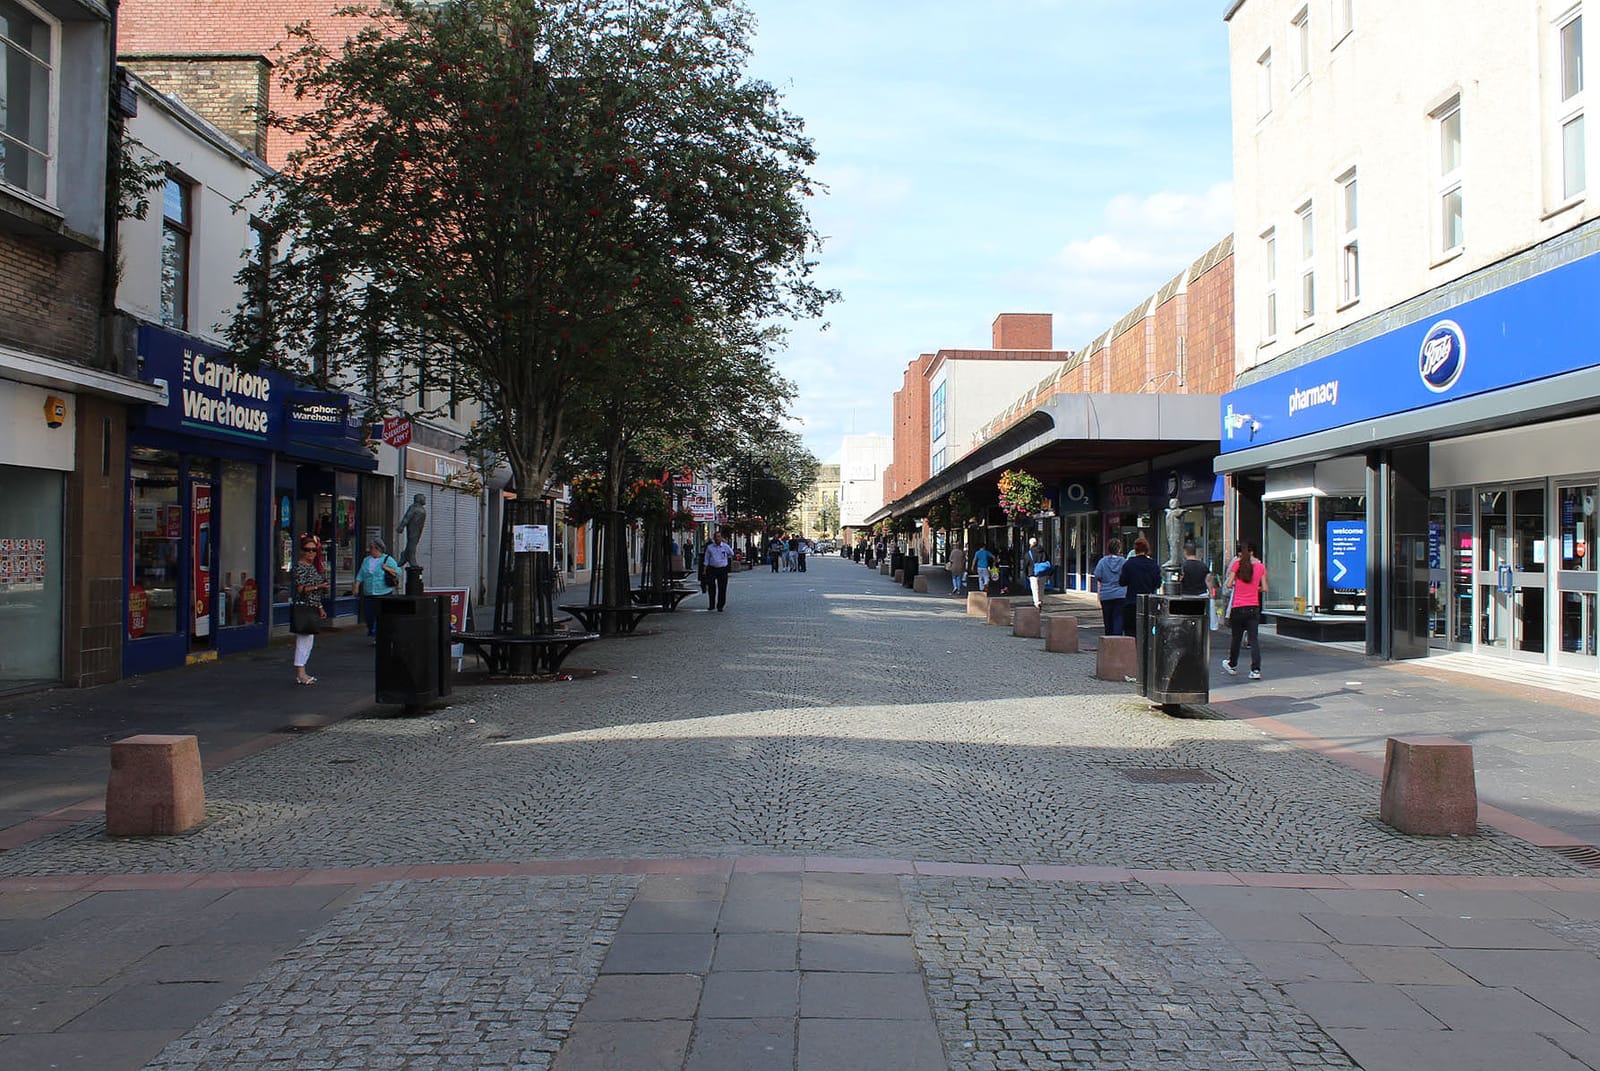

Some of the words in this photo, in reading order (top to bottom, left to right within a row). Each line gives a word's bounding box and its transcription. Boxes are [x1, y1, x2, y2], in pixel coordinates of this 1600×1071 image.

[182, 348, 192, 383] THE
[1422, 333, 1453, 376] Boots
[193, 353, 271, 402] Carphone
[182, 388, 268, 433] Warehouse
[1289, 379, 1339, 417] pharmacy
[1067, 483, 1089, 505] O2
[1332, 527, 1364, 535] welcome
